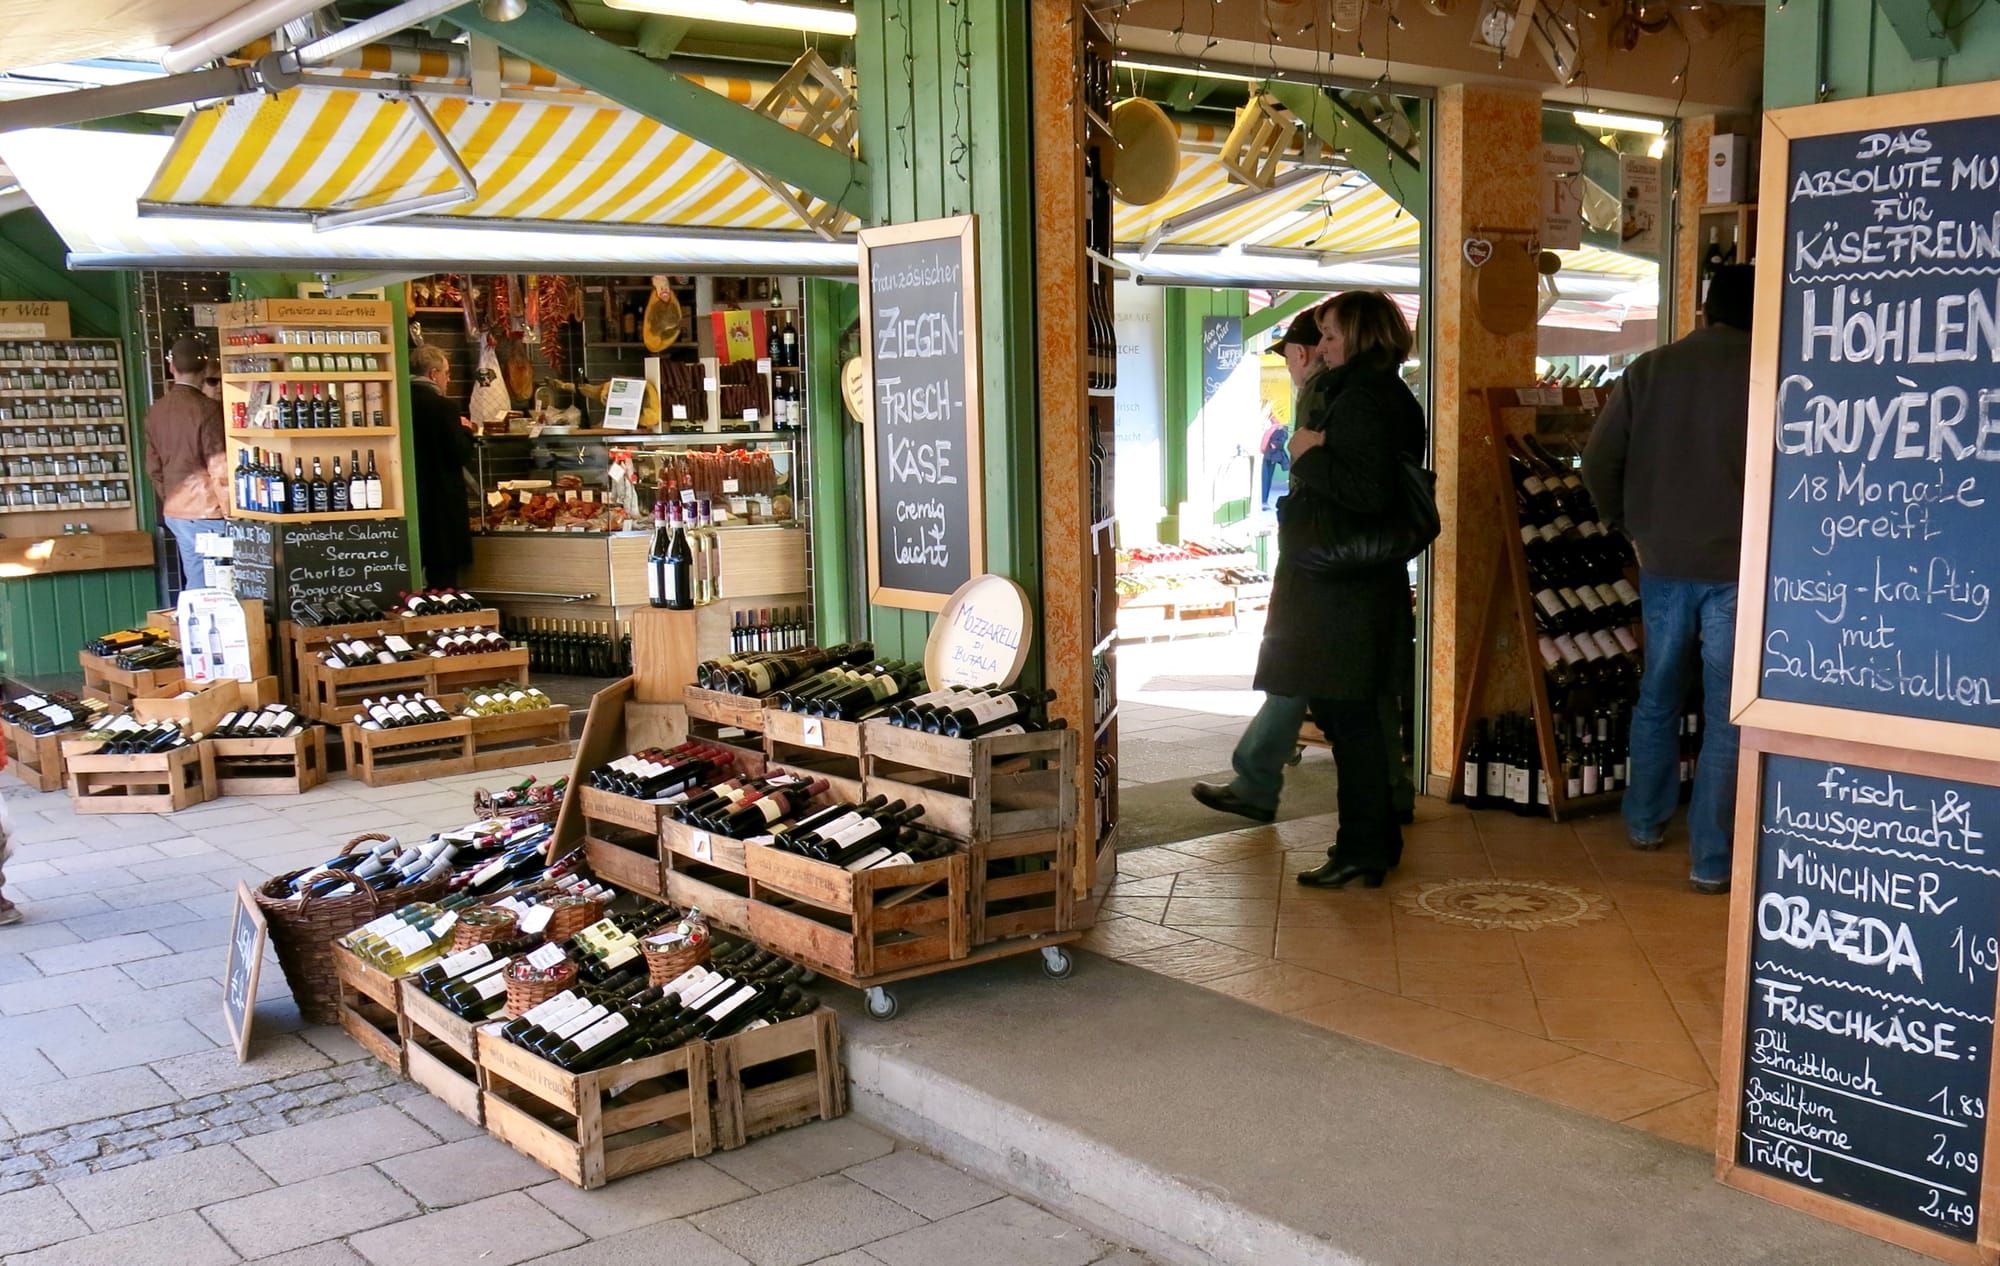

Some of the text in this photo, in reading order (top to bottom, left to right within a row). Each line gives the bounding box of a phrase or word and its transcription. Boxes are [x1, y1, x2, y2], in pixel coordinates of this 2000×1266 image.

[1856, 128, 1933, 159] DAS
[1790, 154, 2000, 203] ABSOLUTE MU
[1871, 192, 1934, 221] FÜR
[871, 253, 960, 294] französischer
[15, 302, 51, 317] Welt
[1801, 277, 2000, 365] HÖHLEN
[1776, 374, 2000, 462] GRUYÈRE
[887, 433, 958, 485] KÄSE
[1788, 460, 1985, 507] 18 Monate
[348, 524, 400, 542] Salami
[896, 497, 946, 539] cremig
[1811, 502, 1942, 556] gereift
[289, 566, 356, 582] Chorizo
[363, 556, 409, 581] picante
[892, 525, 950, 568] leicht
[1842, 614, 1896, 649] mit
[952, 645, 998, 673] BUFALA
[1764, 629, 2000, 707] Salzkristallen
[1776, 780, 1985, 855] hausgemacht
[1818, 766, 1972, 824] frisch &
[1777, 848, 1958, 915] MÜNCHNER
[1757, 892, 1999, 984] OBAZDA 1,69
[1754, 1027, 1791, 1054] Dill
[1751, 1046, 1883, 1096] Schnittlauch
[1745, 1077, 1838, 1124] Basilikum
[1742, 1131, 1824, 1184] Trüffel
[1746, 1100, 1979, 1174] Pinienkerne 2,09
